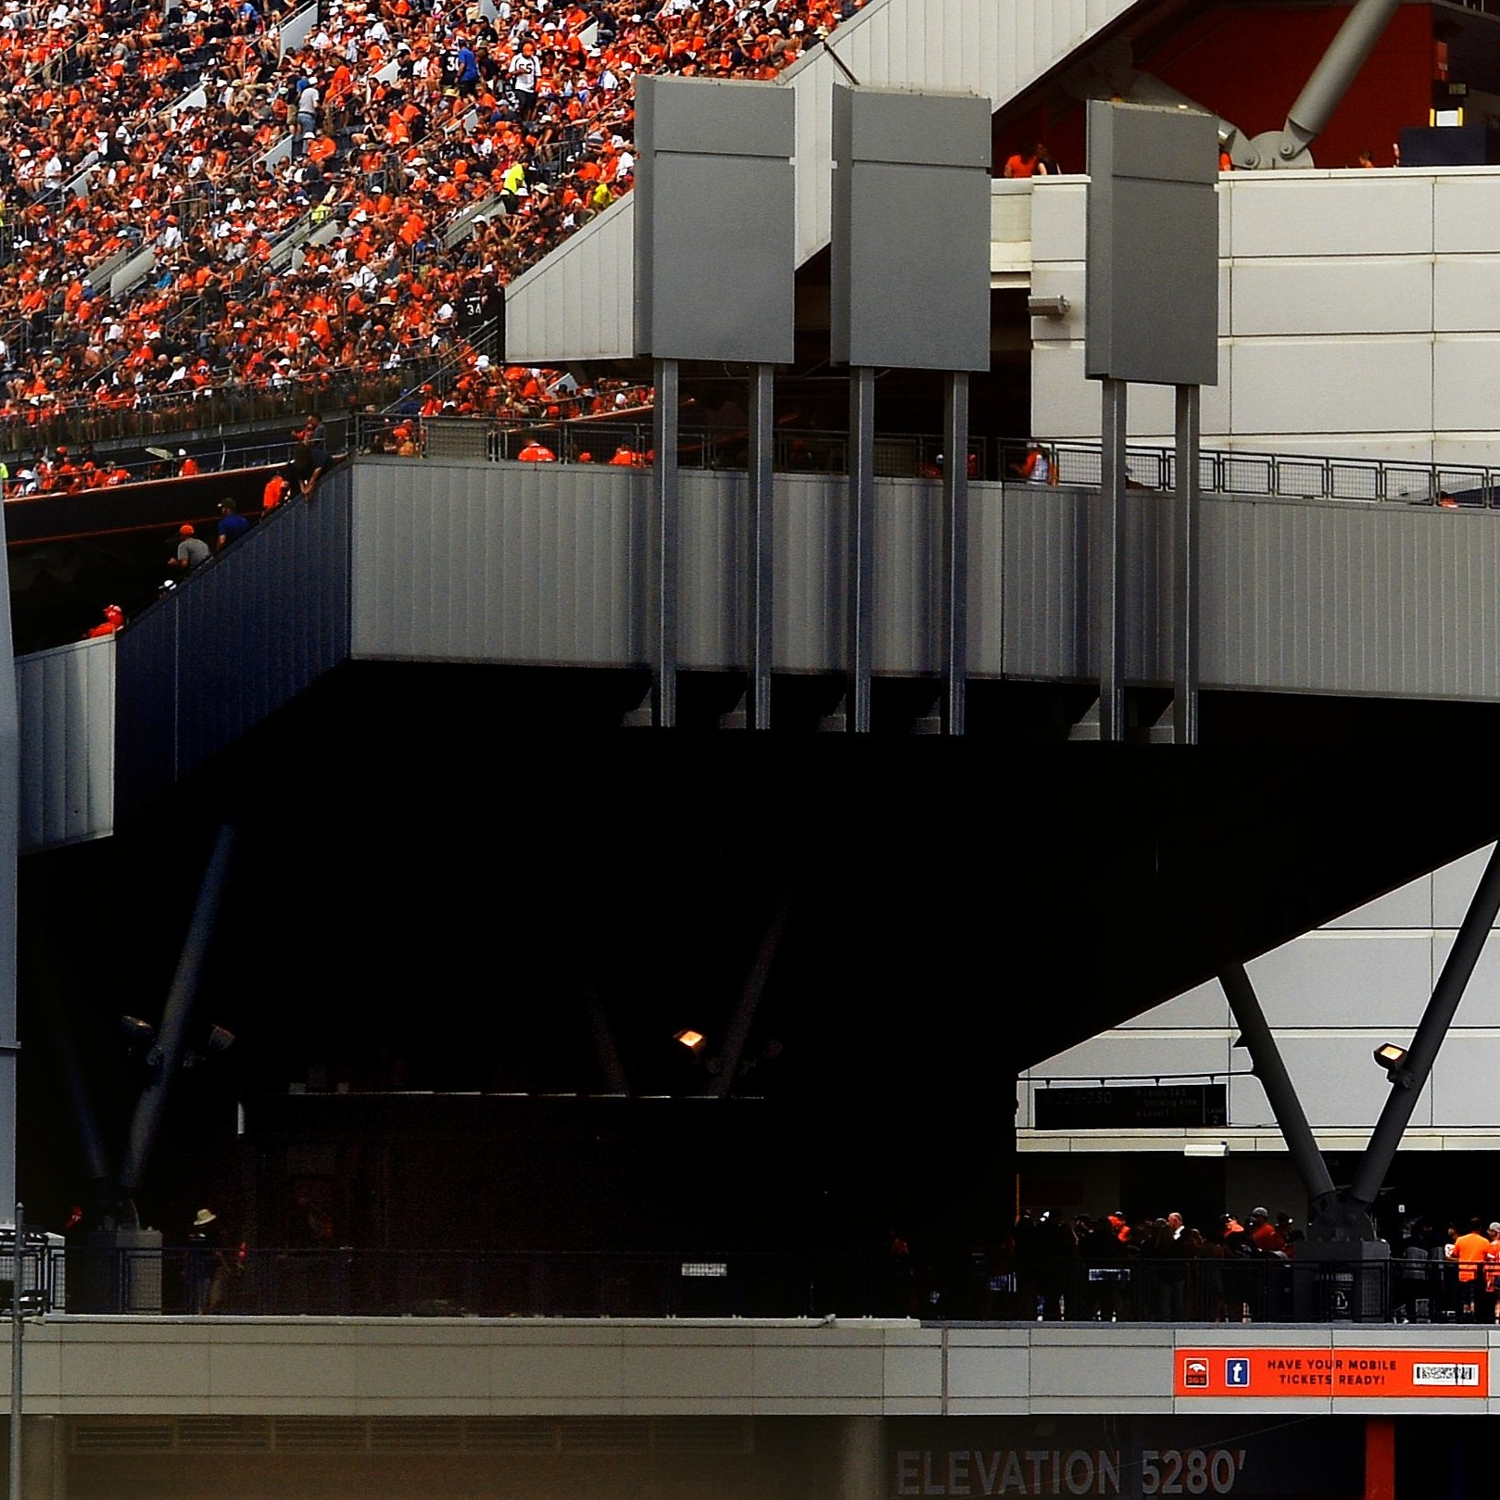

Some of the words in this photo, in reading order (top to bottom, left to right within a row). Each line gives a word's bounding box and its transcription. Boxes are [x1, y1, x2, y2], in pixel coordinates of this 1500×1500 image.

[1267, 1359, 1301, 1370] HAVE
[1306, 1359, 1343, 1370] YOUR
[1348, 1359, 1397, 1371] MOBILE
[1279, 1374, 1332, 1385] TICKETS
[1337, 1374, 1386, 1386] READY!
[897, 1449, 1120, 1495] ELEVATION
[1141, 1449, 1247, 1495] 5280'
